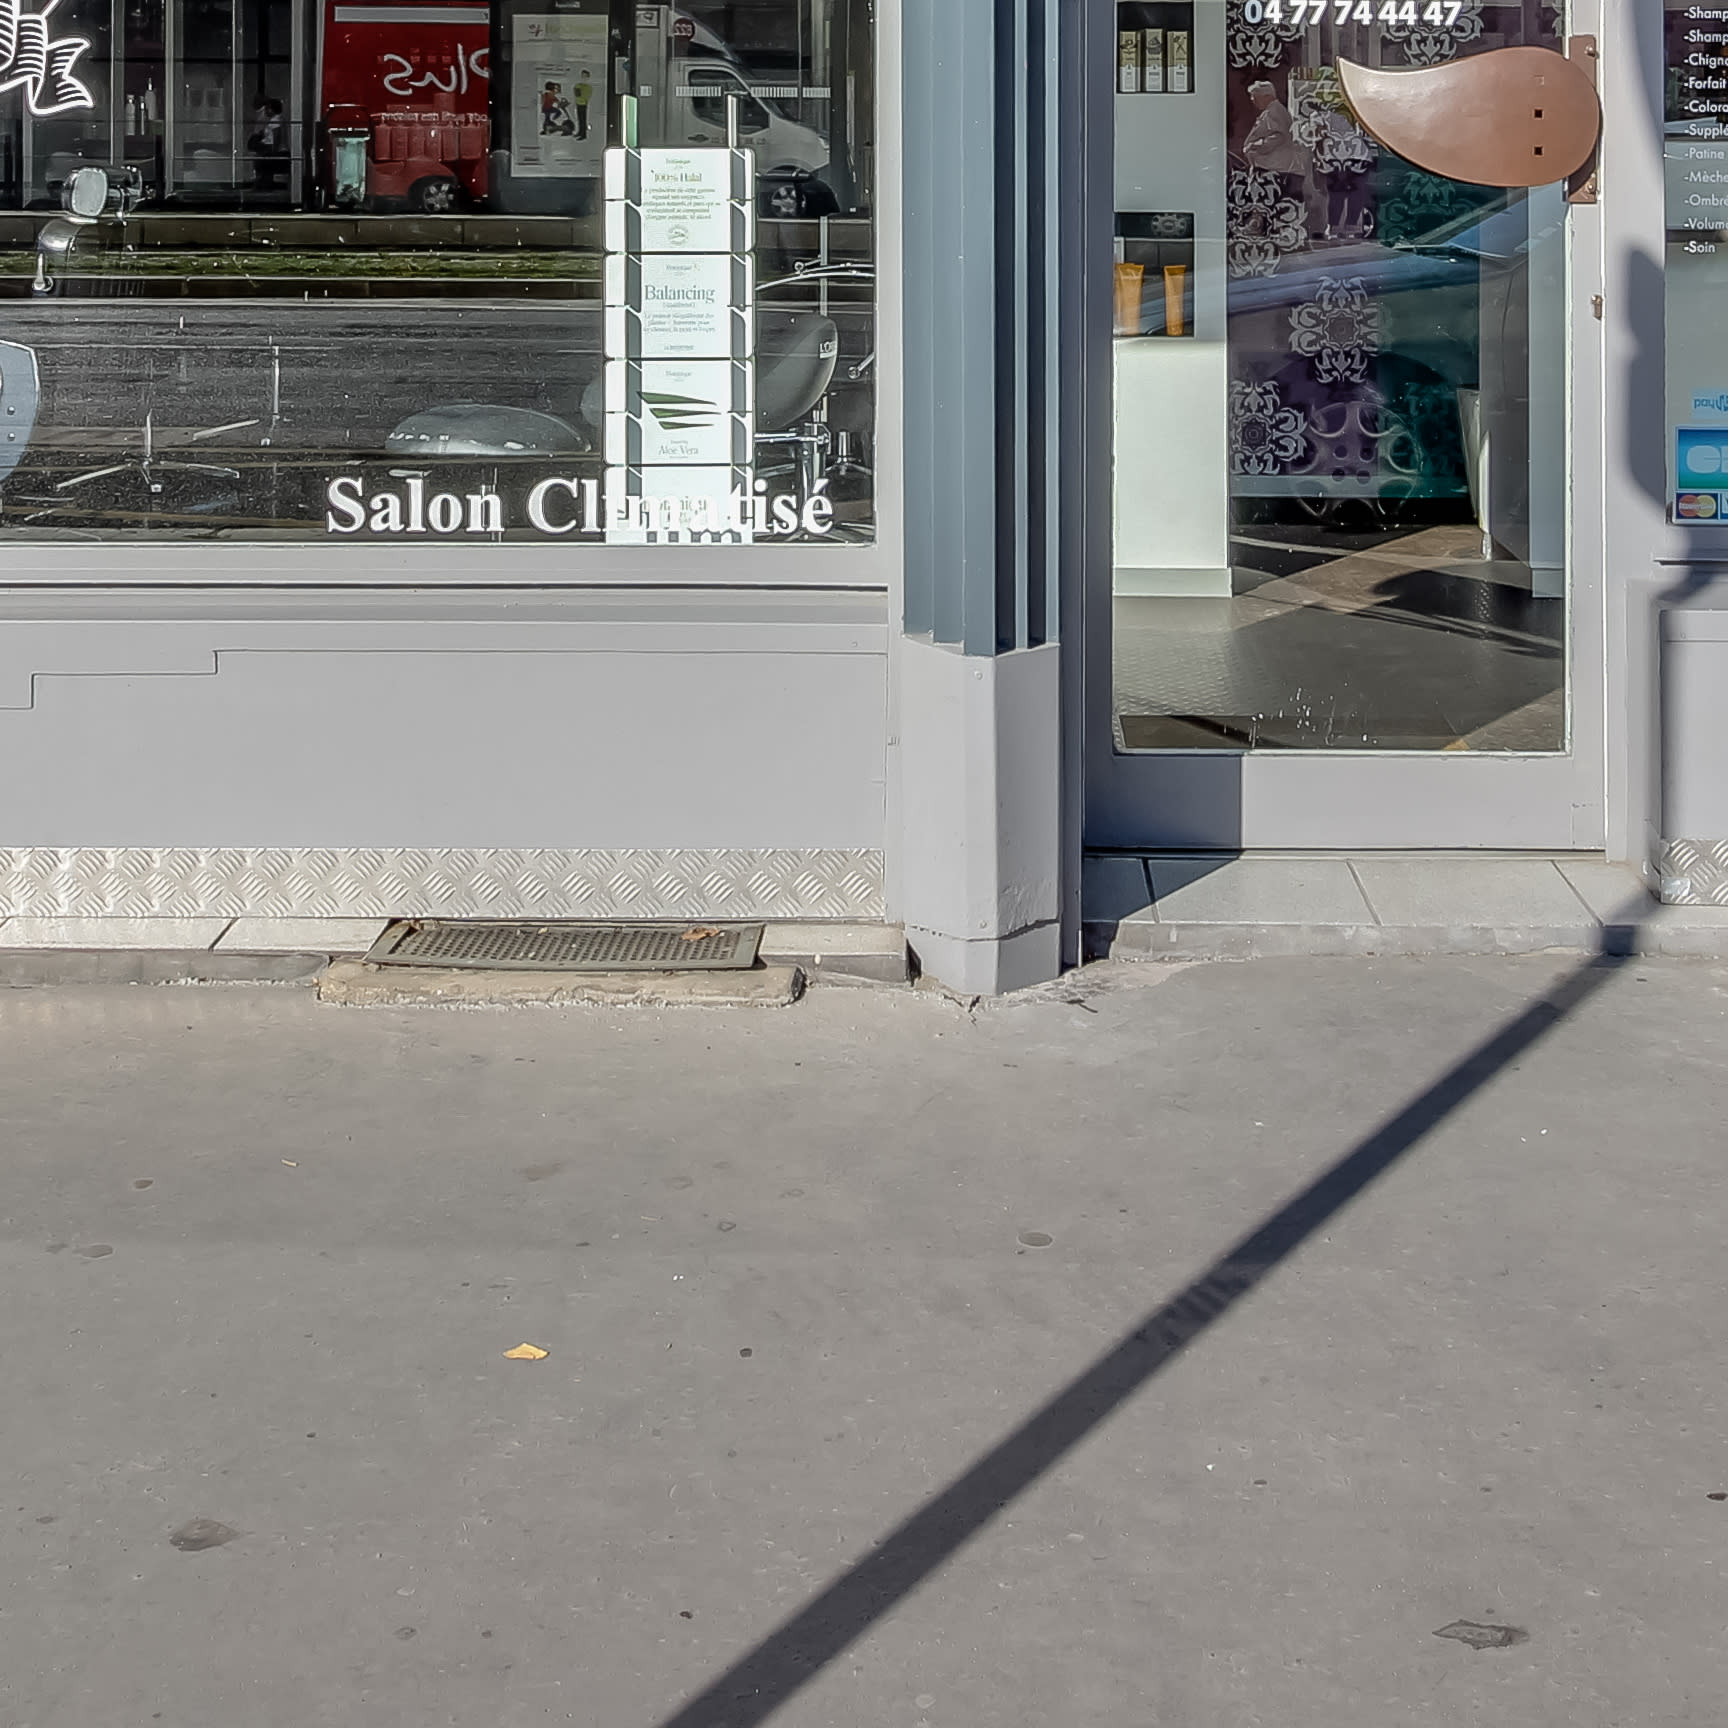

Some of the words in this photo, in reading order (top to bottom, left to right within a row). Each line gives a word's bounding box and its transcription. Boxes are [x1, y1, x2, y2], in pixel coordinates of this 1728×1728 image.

[1244, 0, 1282, 25] 04
[1289, 0, 1327, 25] 77
[1334, 0, 1373, 25] 74
[1378, 0, 1417, 25] 44
[1423, 0, 1463, 25] 47
[645, 284, 715, 303] Balancing
[326, 475, 505, 534] Salon
